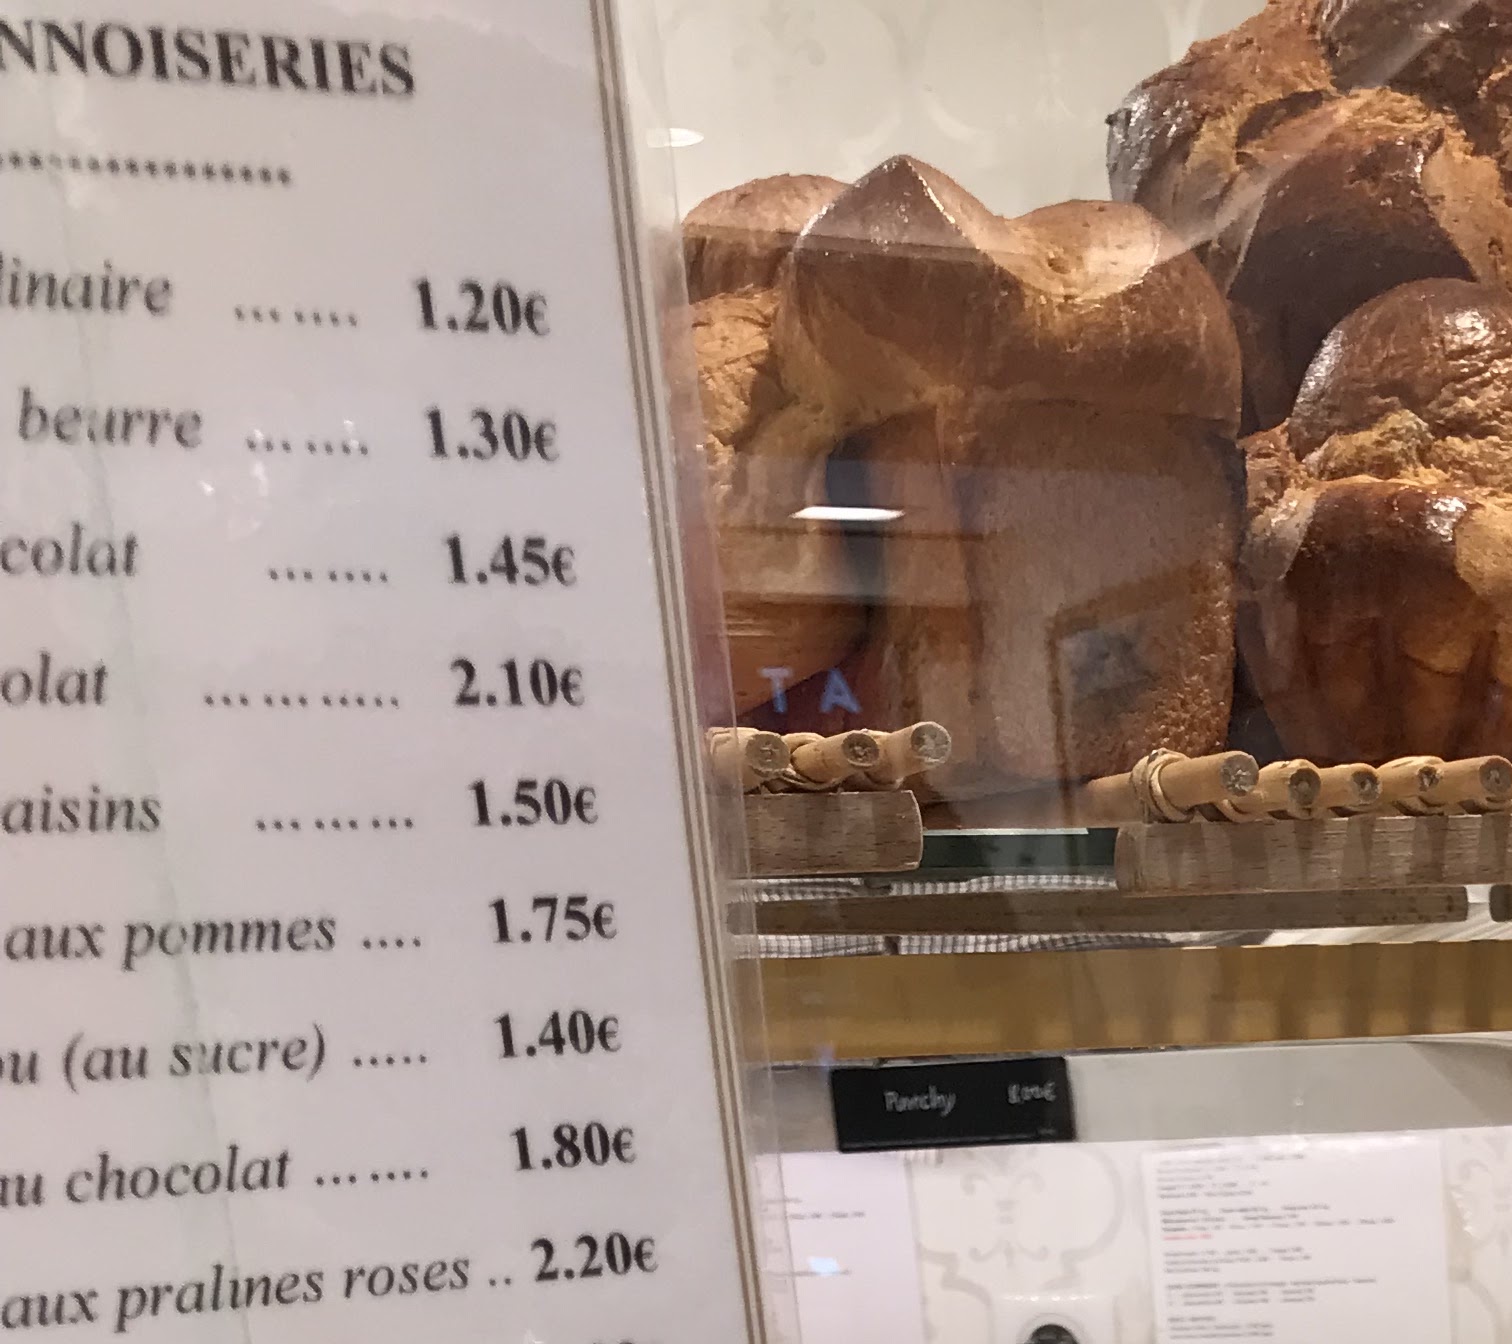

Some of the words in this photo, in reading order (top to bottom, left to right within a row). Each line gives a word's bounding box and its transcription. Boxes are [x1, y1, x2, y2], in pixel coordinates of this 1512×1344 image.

[0, 252, 170, 316] inaire
[417, 280, 546, 335] 1.20€
[19, 387, 201, 447] beurre
[428, 409, 555, 461] 1.30€
[1, 522, 138, 576] colat
[447, 536, 573, 585] 1.45€
[1, 653, 107, 706] olat
[452, 659, 581, 706] 2.10€
[1, 786, 159, 834] aisins
[472, 779, 595, 826] 1.50€
[5, 925, 103, 961] aux
[122, 919, 335, 971] pommes
[491, 896, 615, 942] 1.75€
[63, 1033, 148, 1091] (au
[170, 1025, 325, 1076] sucre)
[496, 1011, 617, 1058] 1.40€
[66, 1141, 289, 1203] chocolat
[512, 1123, 632, 1170] 1.80€
[2, 1291, 97, 1328] aux
[115, 1264, 323, 1333] pralines
[345, 1260, 469, 1297] roses
[532, 1233, 653, 1281] 2.20€
